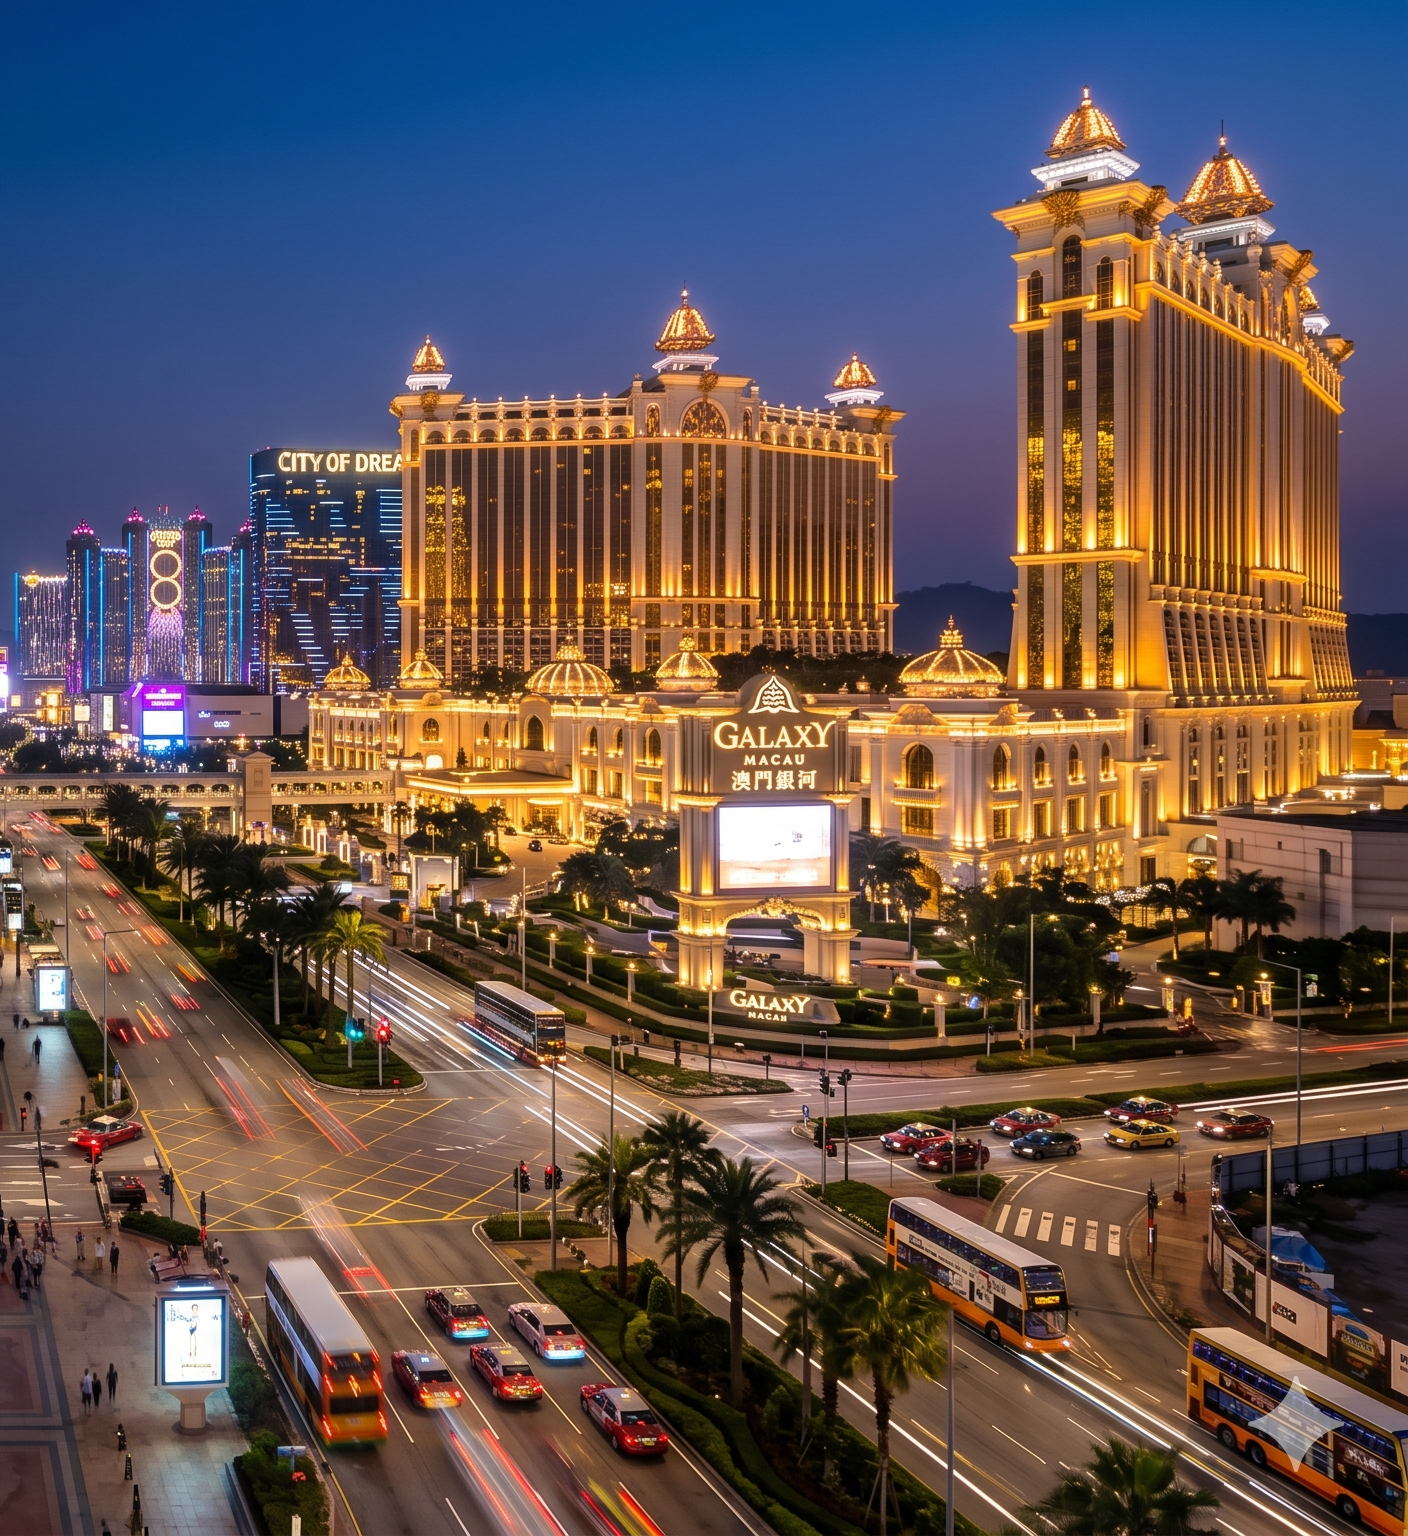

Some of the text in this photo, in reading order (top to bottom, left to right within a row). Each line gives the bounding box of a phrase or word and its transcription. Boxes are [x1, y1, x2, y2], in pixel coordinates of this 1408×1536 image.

[278, 452, 324, 472] CITY
[326, 452, 351, 472] OF
[713, 719, 837, 750] GALAXY
[743, 753, 805, 766] MACAU
[731, 769, 818, 792] 澳門銀河
[729, 989, 811, 1013] GALAXY
